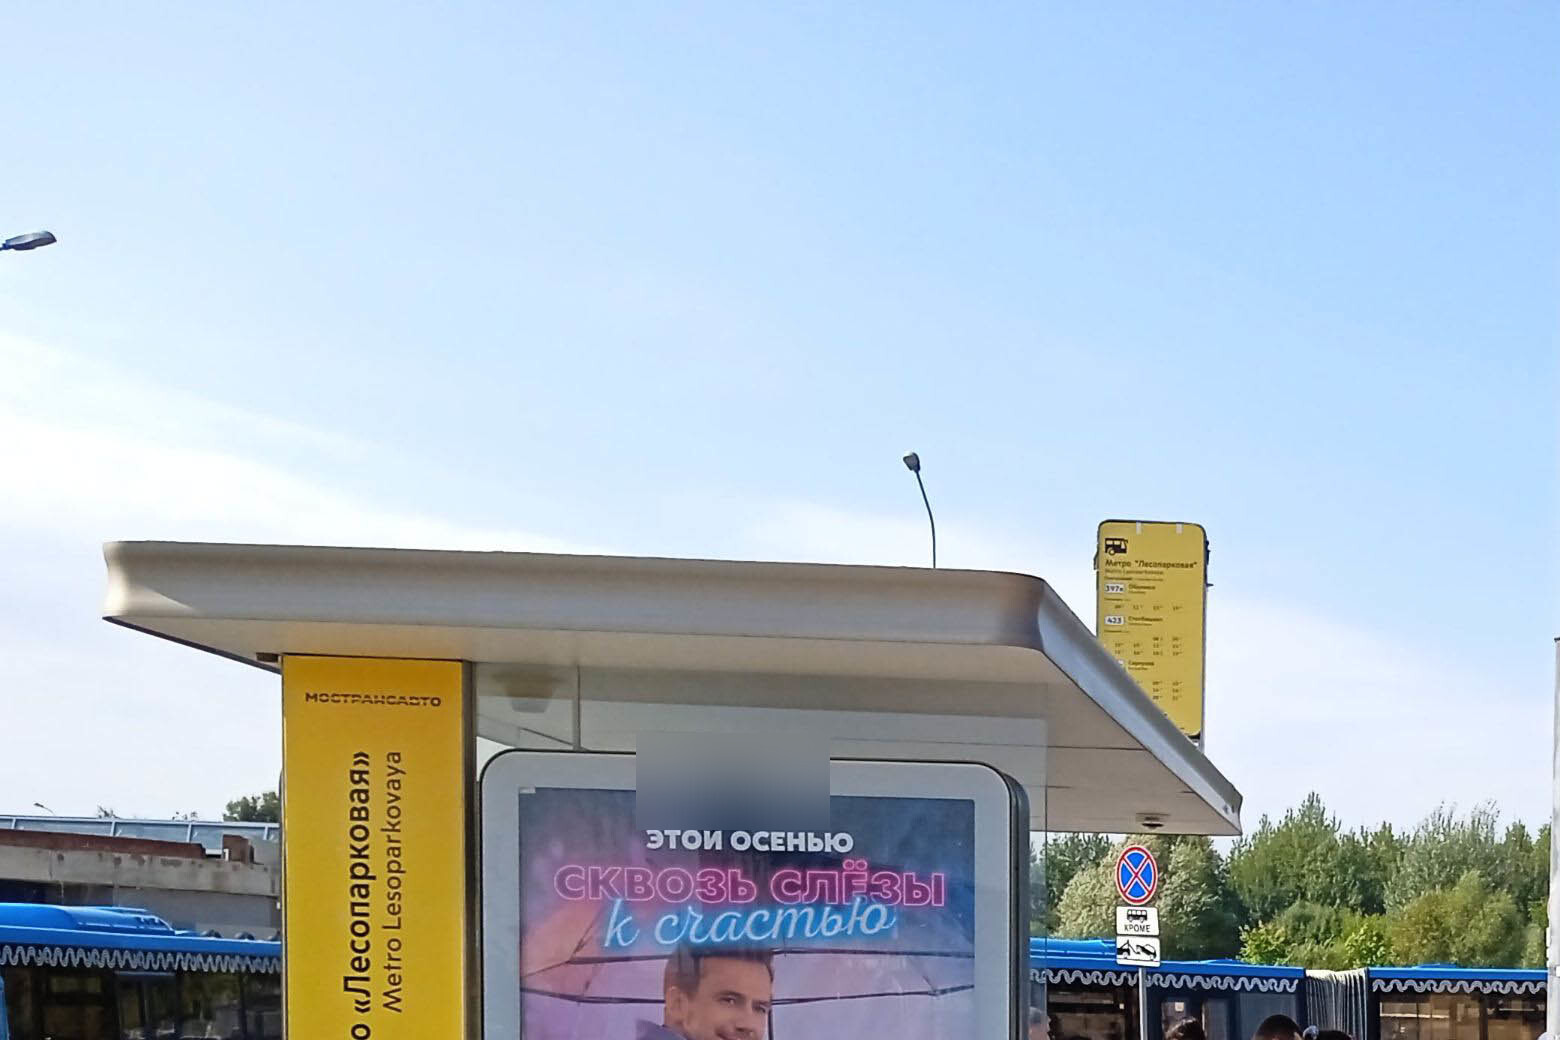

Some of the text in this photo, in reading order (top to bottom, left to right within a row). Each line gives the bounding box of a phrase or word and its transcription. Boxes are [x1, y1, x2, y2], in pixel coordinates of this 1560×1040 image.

[305, 693, 441, 707] МОСТРАНСАВТО
[730, 831, 854, 853] ОСЕНЬЮ
[343, 751, 377, 1015] «Лесопарковая»
[380, 751, 407, 1013] Metro Lesoparkovaya
[553, 859, 945, 907] СКВОЗЬ СЛЁЗЫ
[605, 894, 897, 948] к счастью
[1124, 924, 1151, 933] КРОМЕ
